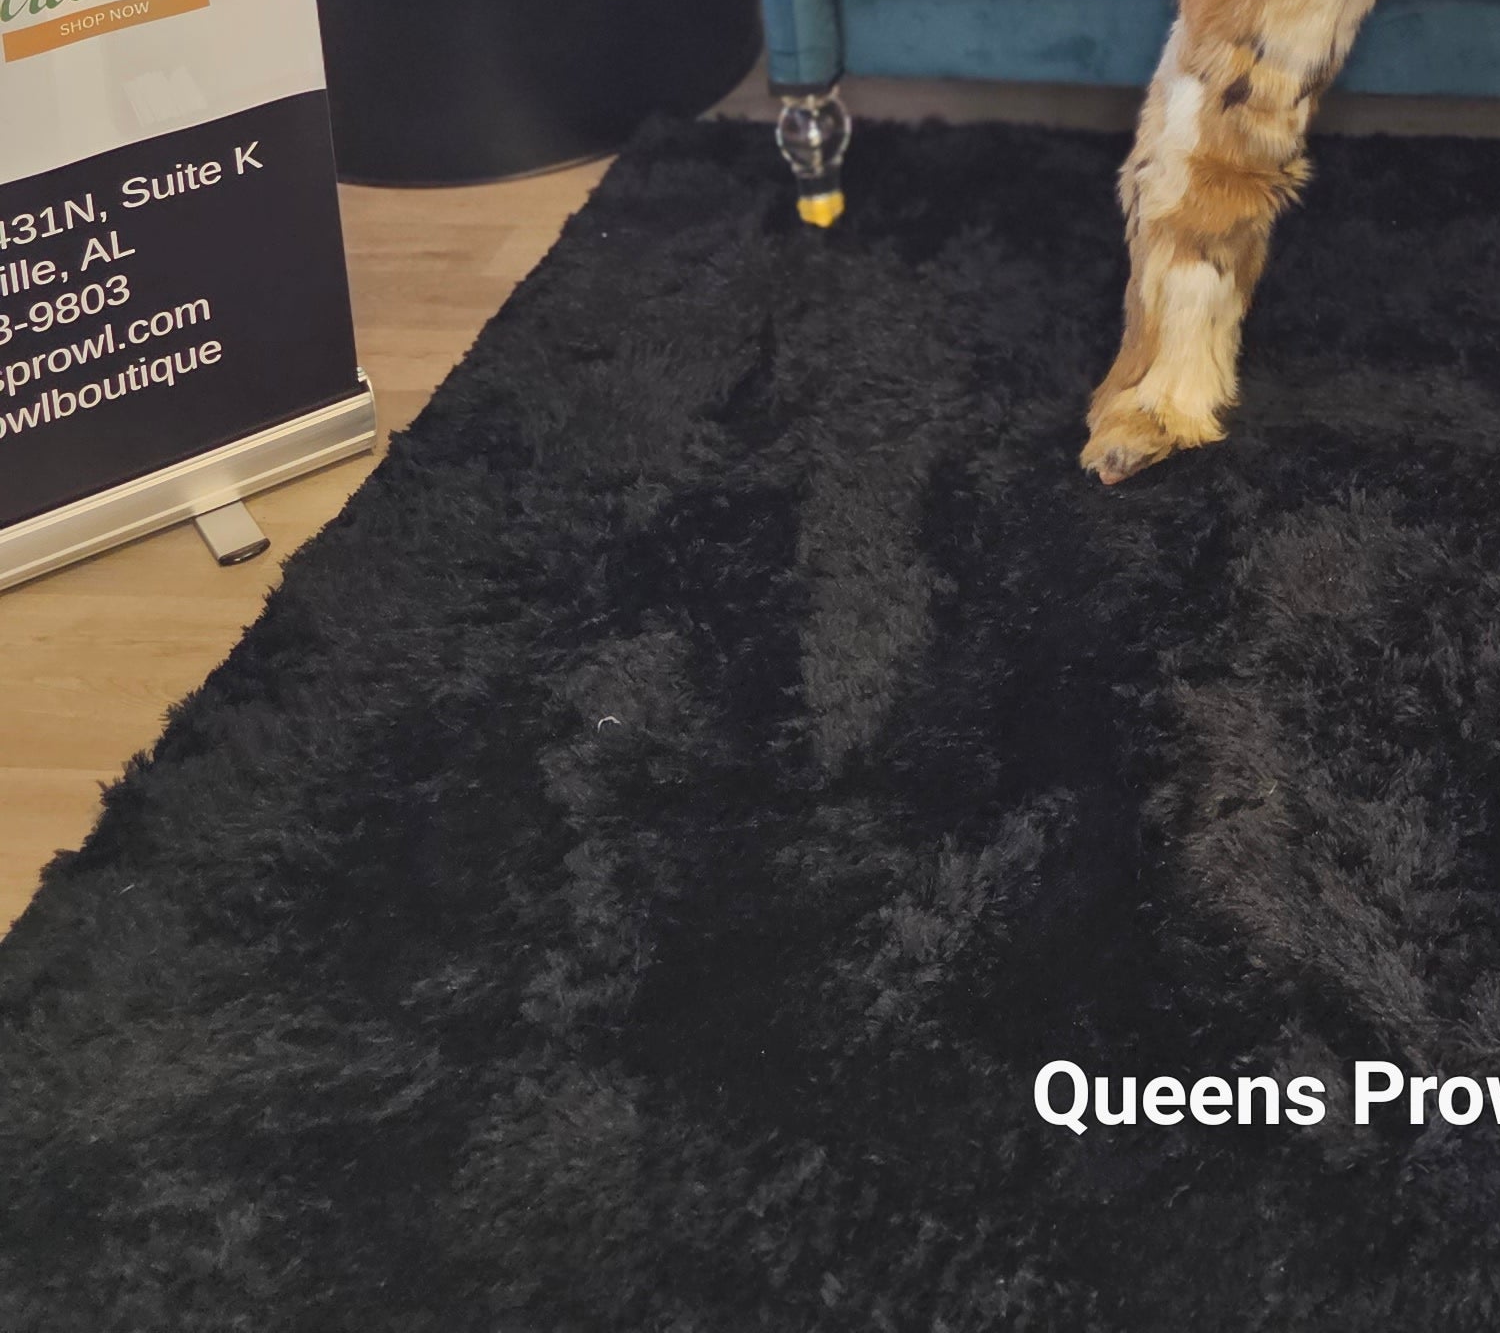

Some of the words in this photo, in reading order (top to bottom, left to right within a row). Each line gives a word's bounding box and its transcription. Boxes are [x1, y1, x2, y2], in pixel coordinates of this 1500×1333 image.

[59, 12, 105, 37] SHOP
[109, 0, 150, 22] NOW
[121, 160, 222, 209] Suite
[234, 141, 264, 175] K
[80, 230, 136, 272] AL
[0, 297, 212, 397] prowl.com
